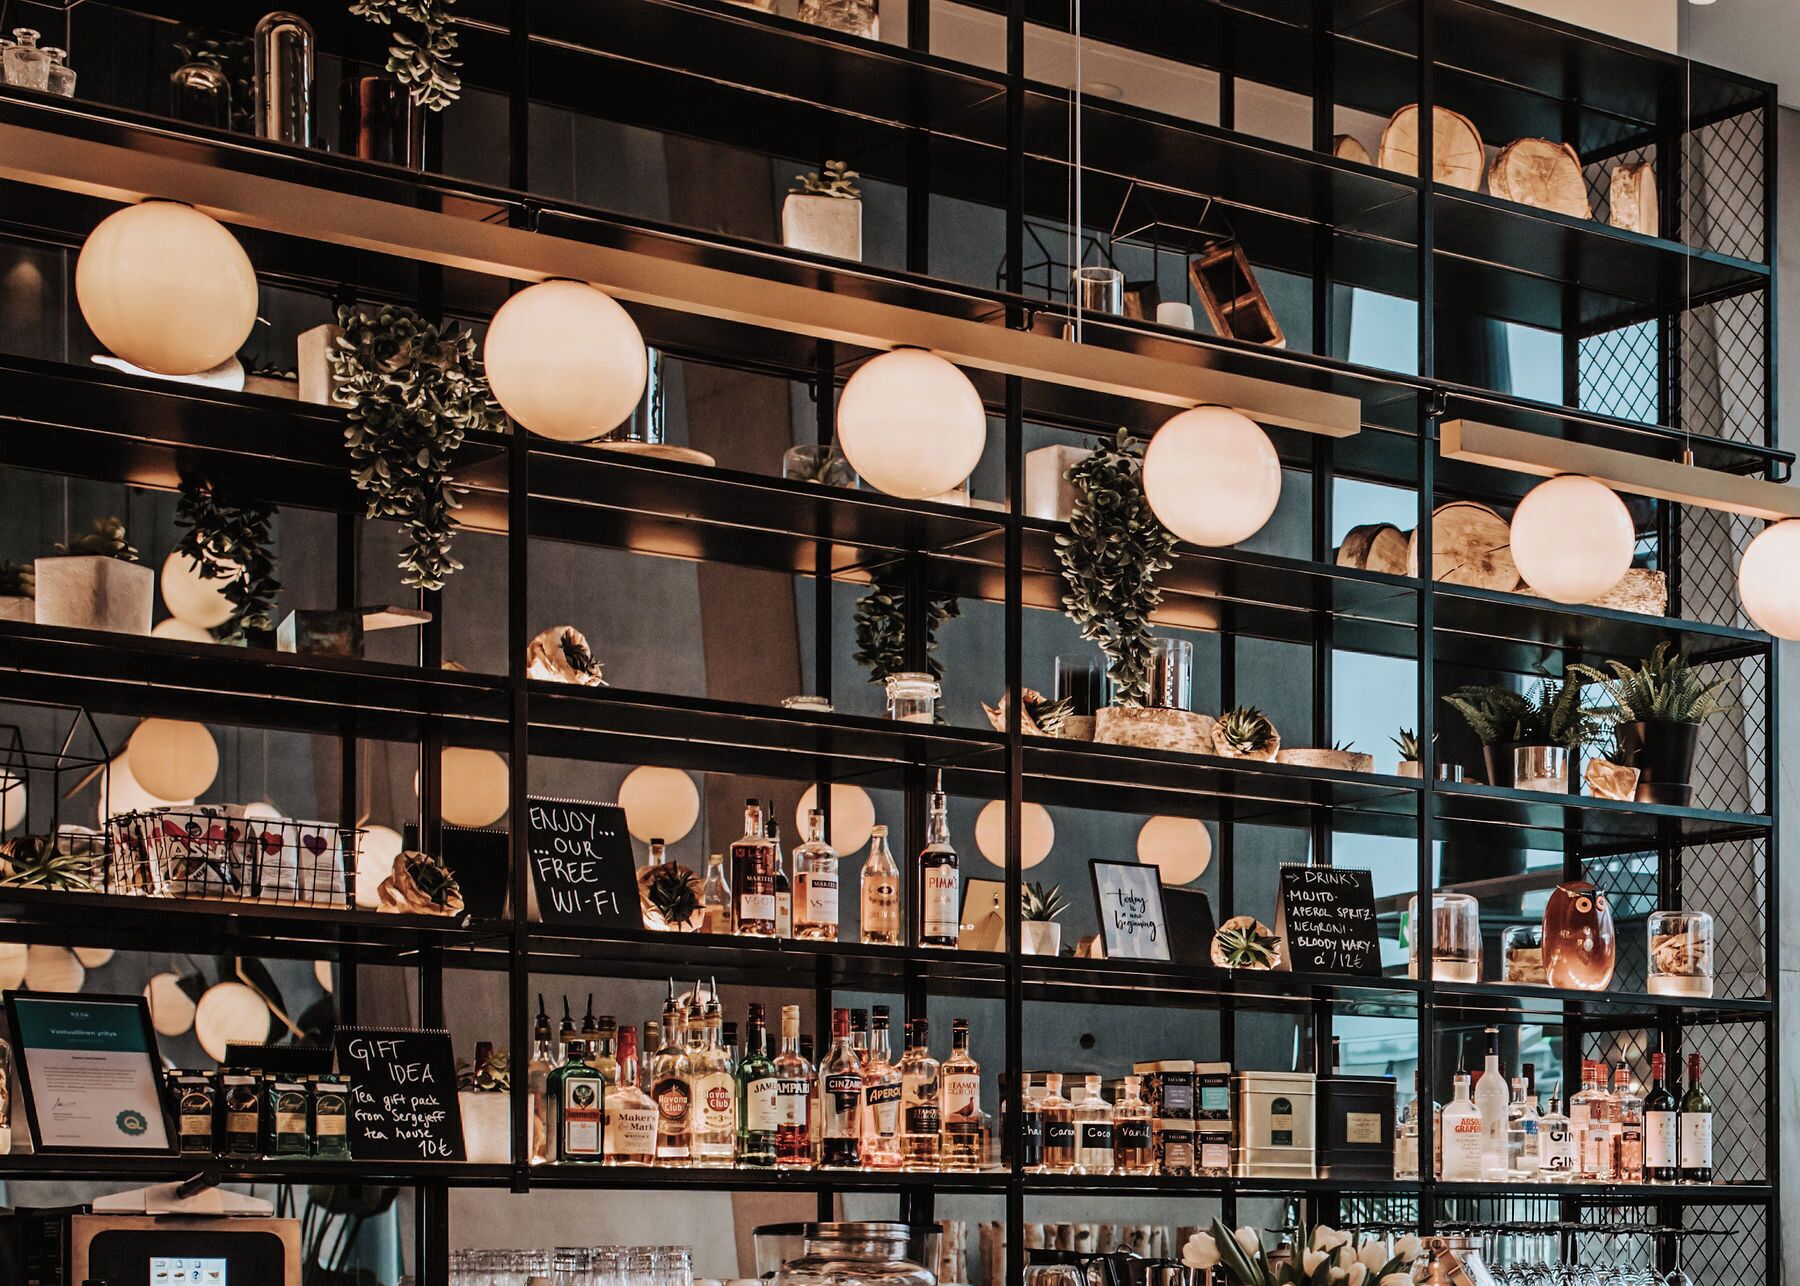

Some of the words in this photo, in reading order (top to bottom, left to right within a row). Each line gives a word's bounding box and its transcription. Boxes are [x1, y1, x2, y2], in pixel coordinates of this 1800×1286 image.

[537, 857, 598, 883] FREE
[929, 876, 958, 889] PIMM'S
[1305, 871, 1359, 887] DRINKS
[551, 886, 619, 915] WI-FI
[810, 899, 823, 907] VS
[1106, 888, 1149, 913] today
[1292, 906, 1333, 918] APEROL
[1337, 907, 1371, 920] SPRITZ
[1114, 910, 1163, 941] beginning
[1294, 921, 1346, 935] NEGRONI
[1298, 936, 1337, 950] BLOODY
[1341, 939, 1371, 954] MARY
[349, 1039, 405, 1071] GIFT
[388, 1062, 435, 1084] IDEA
[777, 1082, 810, 1094] AMPARI
[352, 1085, 375, 1103] Tea
[383, 1094, 406, 1111] gift
[411, 1095, 439, 1111] pack
[658, 1095, 688, 1103] Havana
[710, 1099, 728, 1108] Club
[664, 1103, 683, 1112] Club
[355, 1109, 384, 1121] from
[364, 1127, 388, 1139] tea
[396, 1127, 433, 1139] house
[629, 1122, 655, 1131] Mark
[1087, 1127, 1111, 1138] Coco
[418, 1138, 452, 1157] 10€
